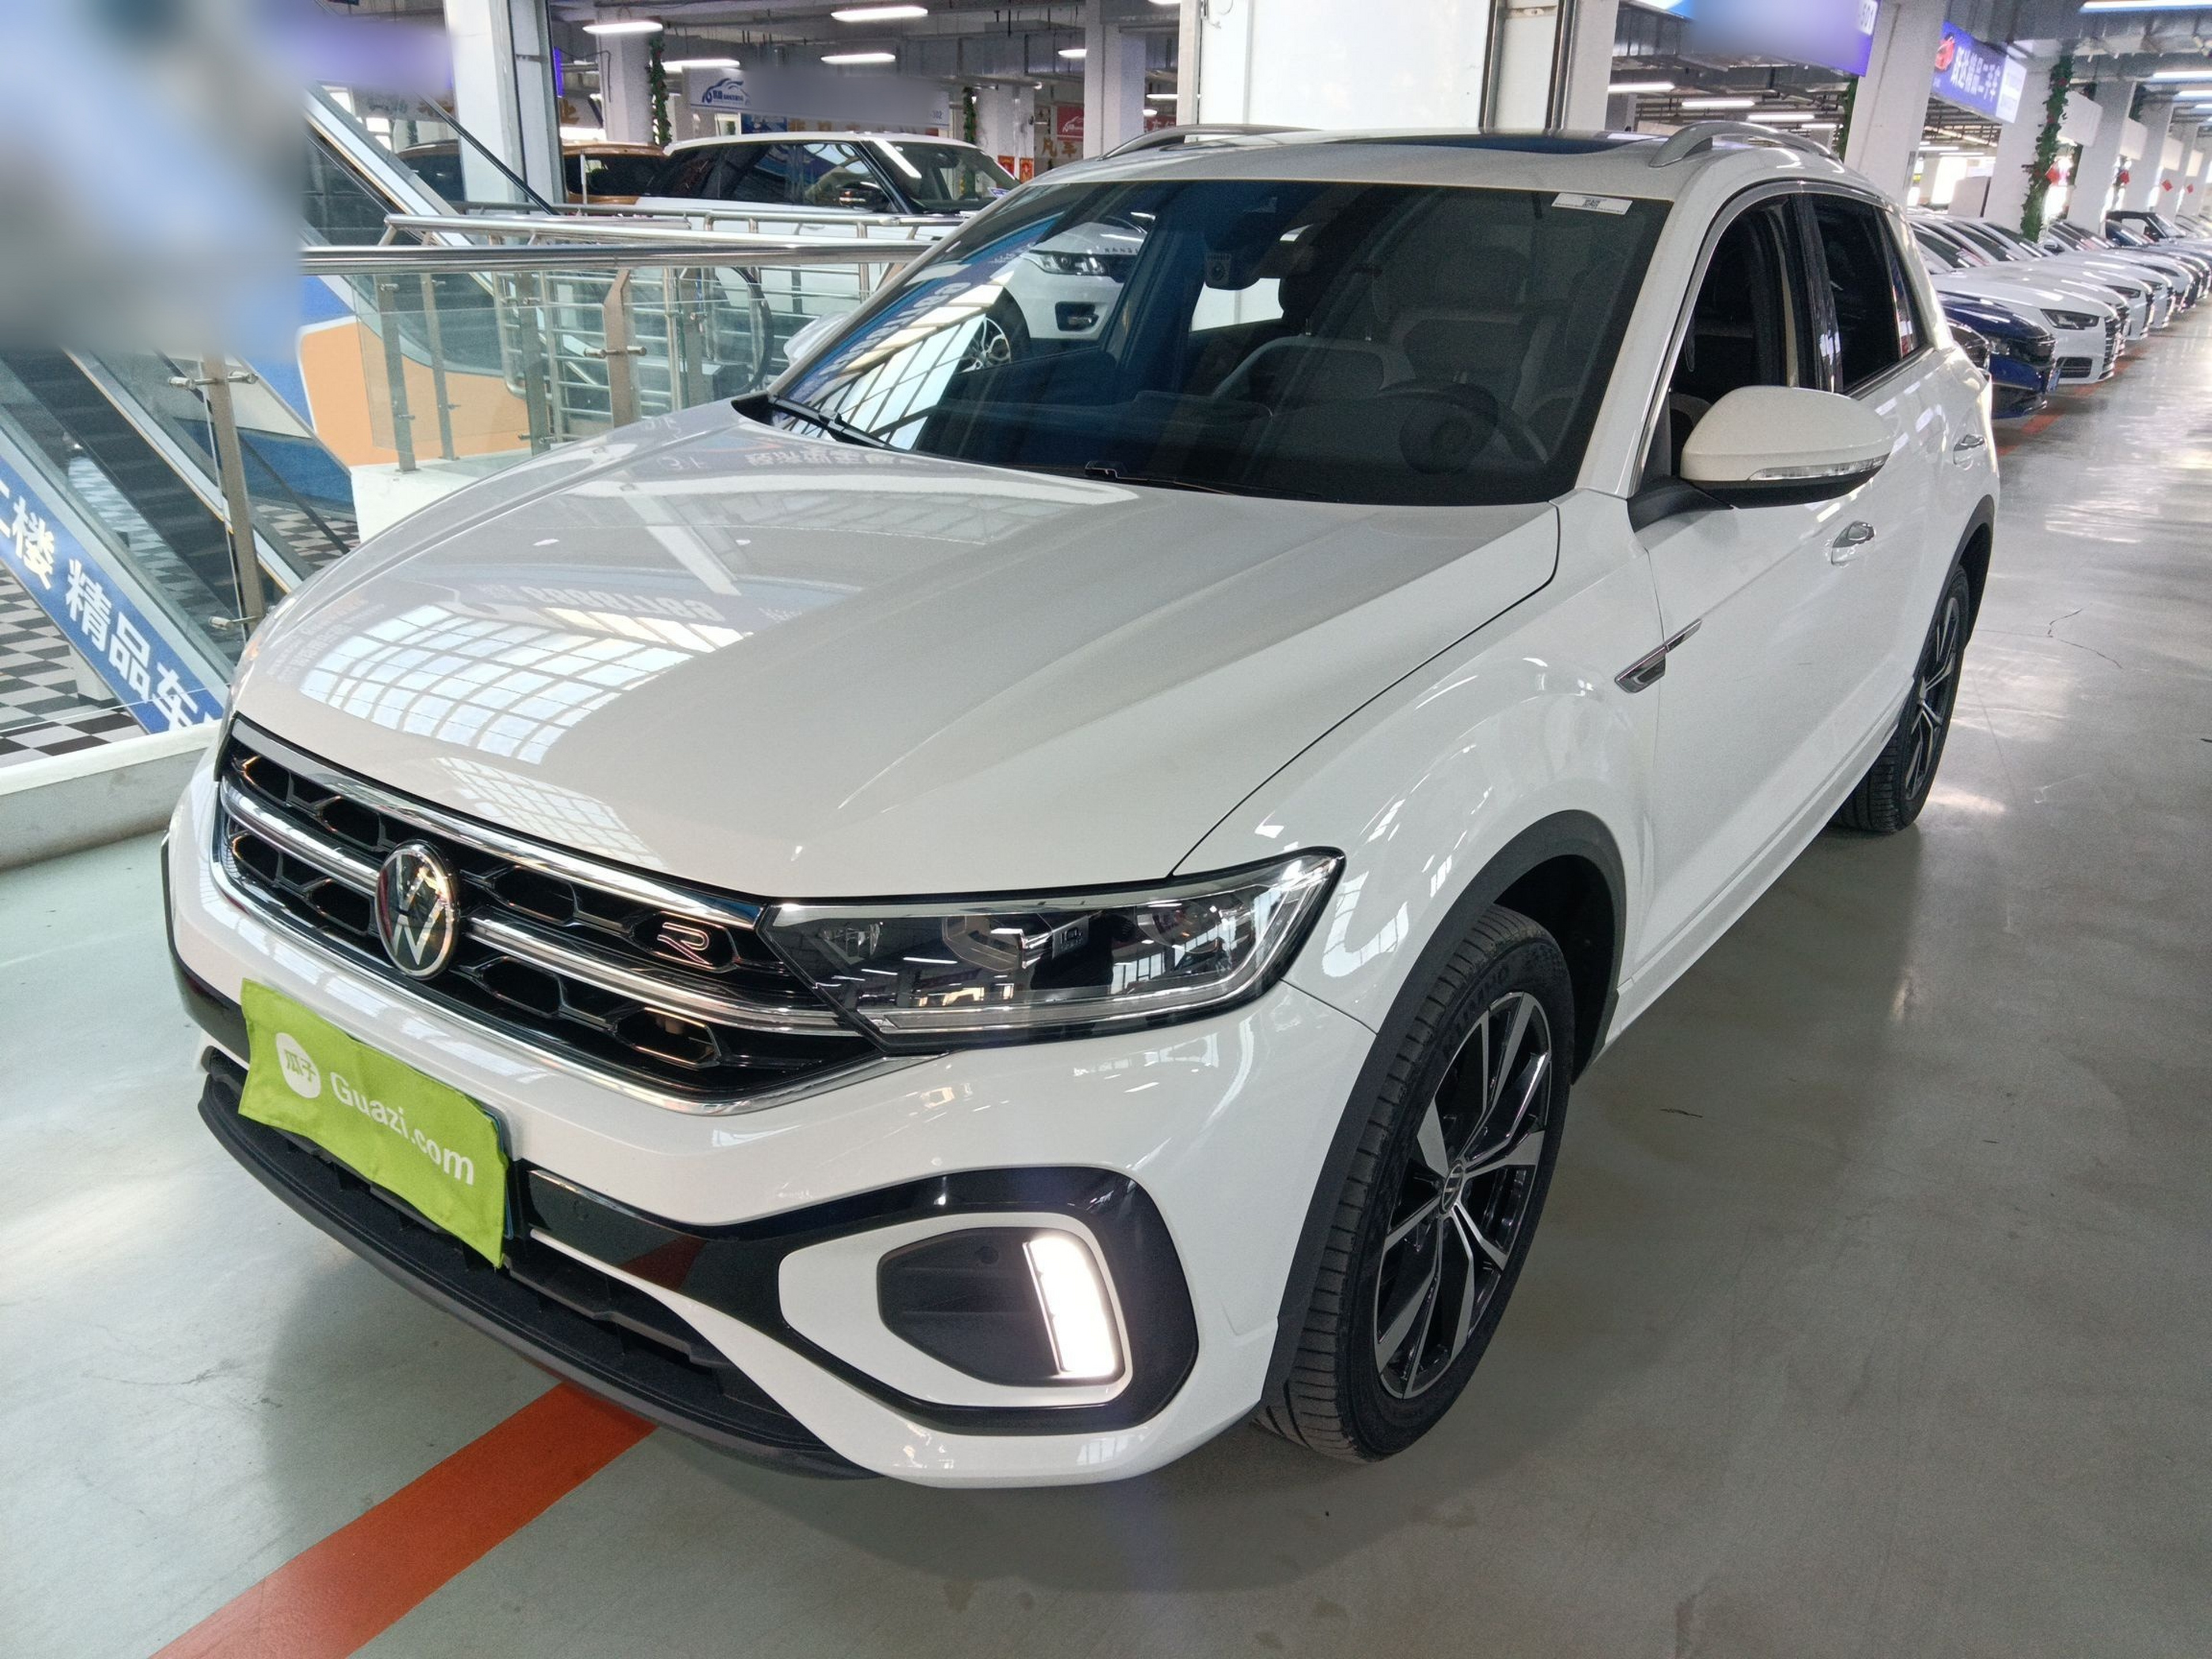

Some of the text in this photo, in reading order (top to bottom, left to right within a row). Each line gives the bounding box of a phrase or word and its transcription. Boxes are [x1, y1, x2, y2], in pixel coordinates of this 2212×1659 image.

[65, 559, 214, 730] 精品车
[283, 1048, 316, 1083] 瓜子
[329, 1071, 475, 1187] Guazi.com
